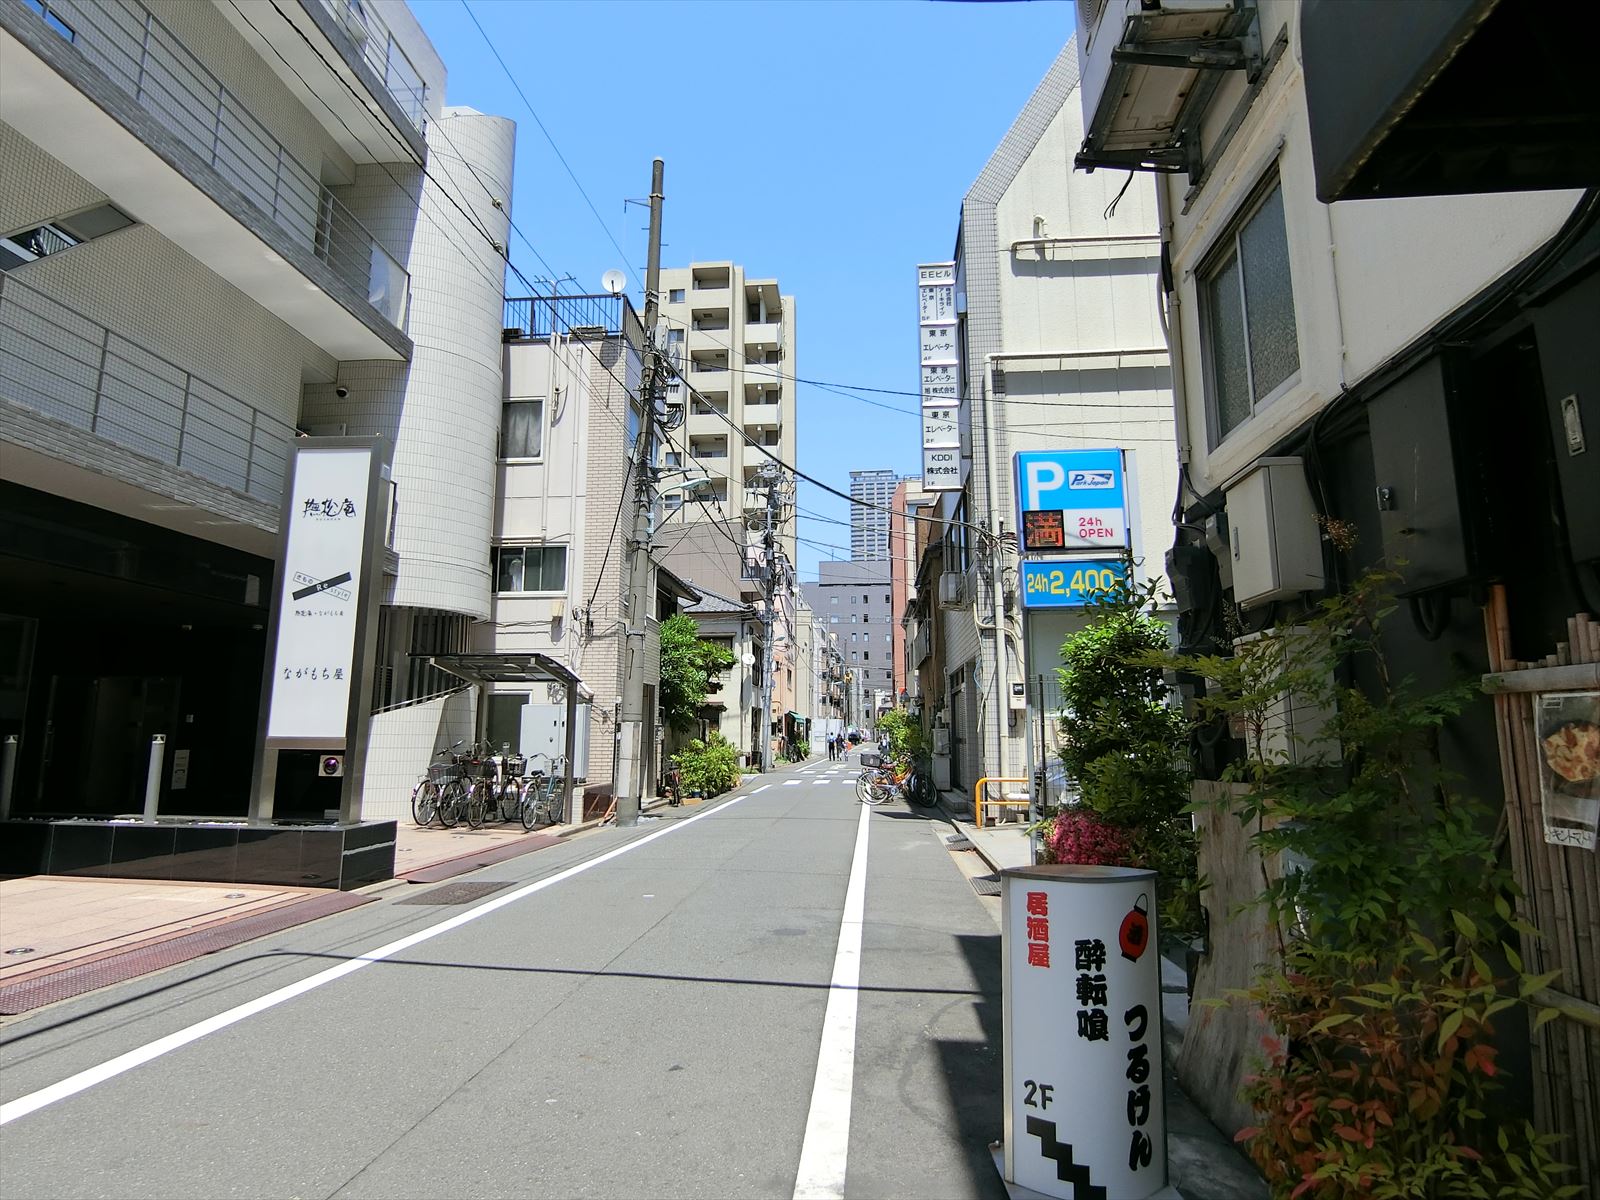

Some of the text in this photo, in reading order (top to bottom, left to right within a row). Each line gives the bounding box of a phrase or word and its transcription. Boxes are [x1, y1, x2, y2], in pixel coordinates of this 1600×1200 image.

[921, 270, 952, 279] EEビル
[929, 329, 948, 337] 東京
[923, 343, 954, 351] エレベーター
[930, 366, 949, 374] 東京
[924, 375, 955, 383] エレベーター
[931, 410, 950, 419] 東京
[925, 425, 957, 433] エレベーター
[926, 466, 958, 475] 株式会社
[1071, 473, 1087, 486] Park
[1026, 461, 1065, 511] P
[1078, 517, 1102, 527] 24h
[1026, 512, 1063, 547] 満
[1079, 528, 1114, 538] OPEN
[316, 583, 329, 591] Re
[1027, 573, 1049, 593] 24h
[283, 667, 344, 680] ながもち屋
[1026, 891, 1051, 969] 居酒屋
[1124, 1004, 1153, 1172] つるけん
[1023, 1079, 1055, 1110] 2F
